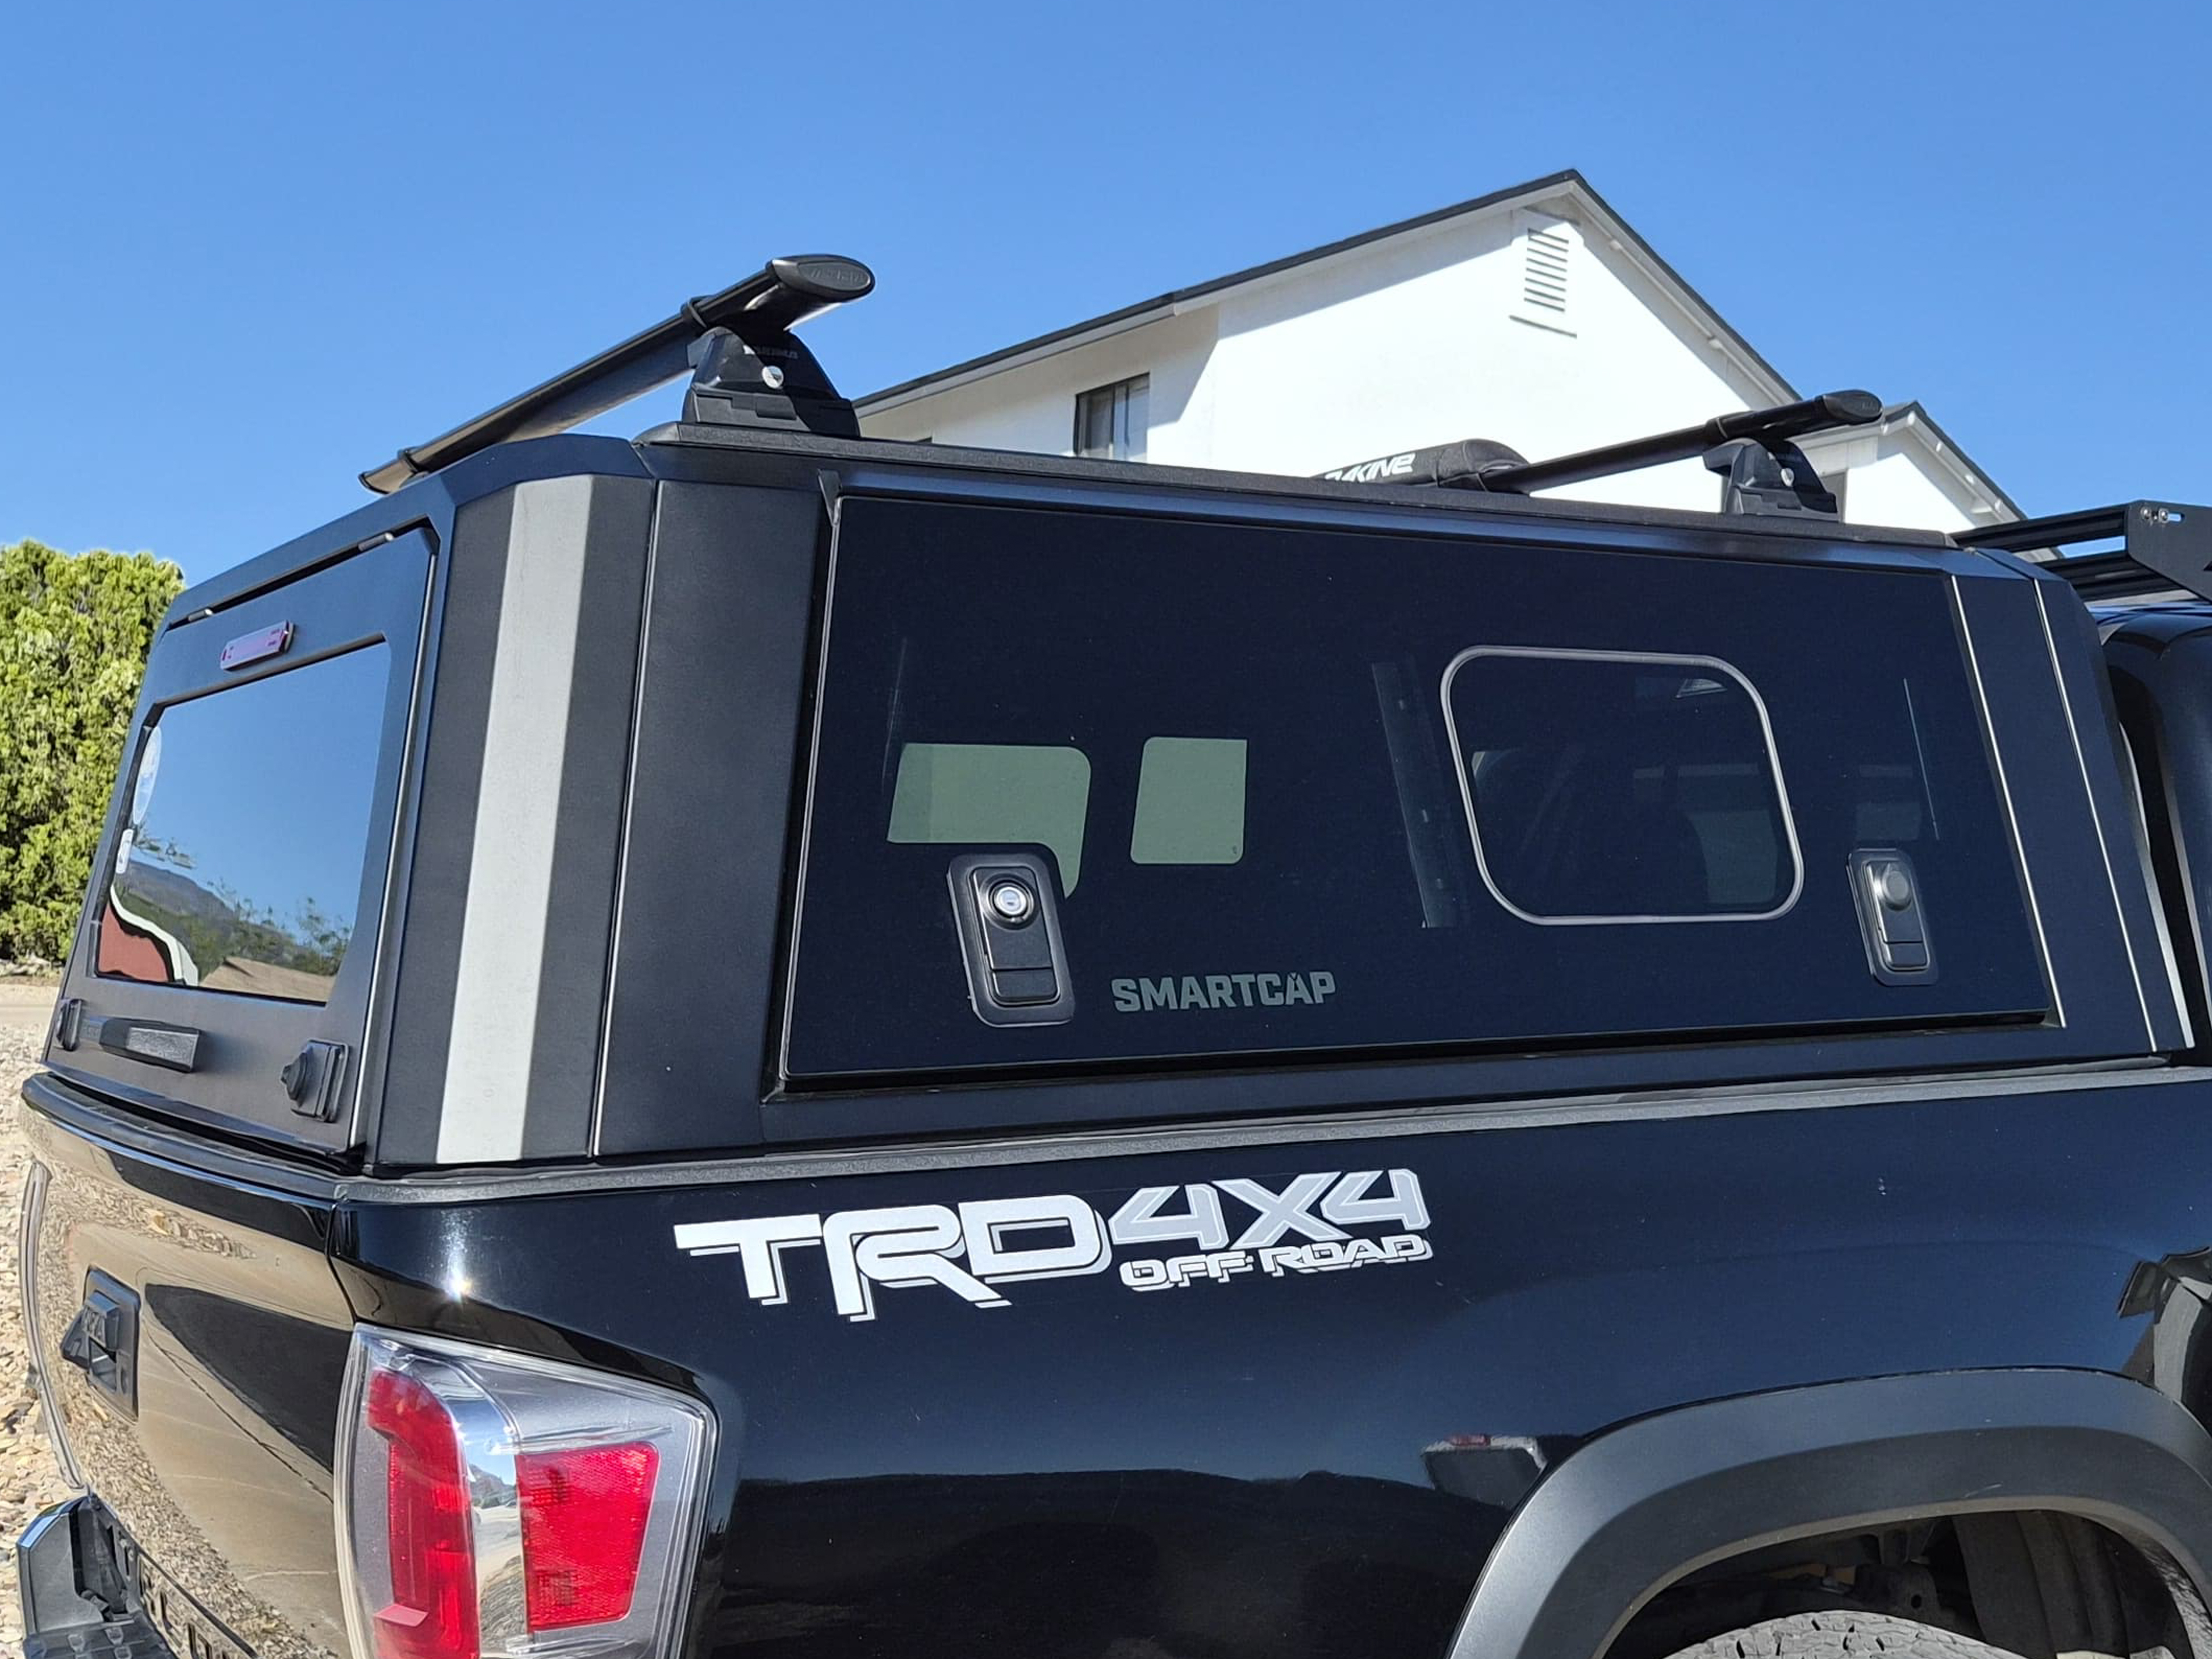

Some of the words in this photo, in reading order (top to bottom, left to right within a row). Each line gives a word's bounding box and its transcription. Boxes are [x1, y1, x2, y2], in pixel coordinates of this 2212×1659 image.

[1111, 971, 1336, 1012] SMARTCAP
[673, 1194, 1113, 1323] TRD
[1108, 1168, 1431, 1250] 4X4
[1119, 1250, 1254, 1292] OFF
[1258, 1233, 1434, 1277] ROAD
